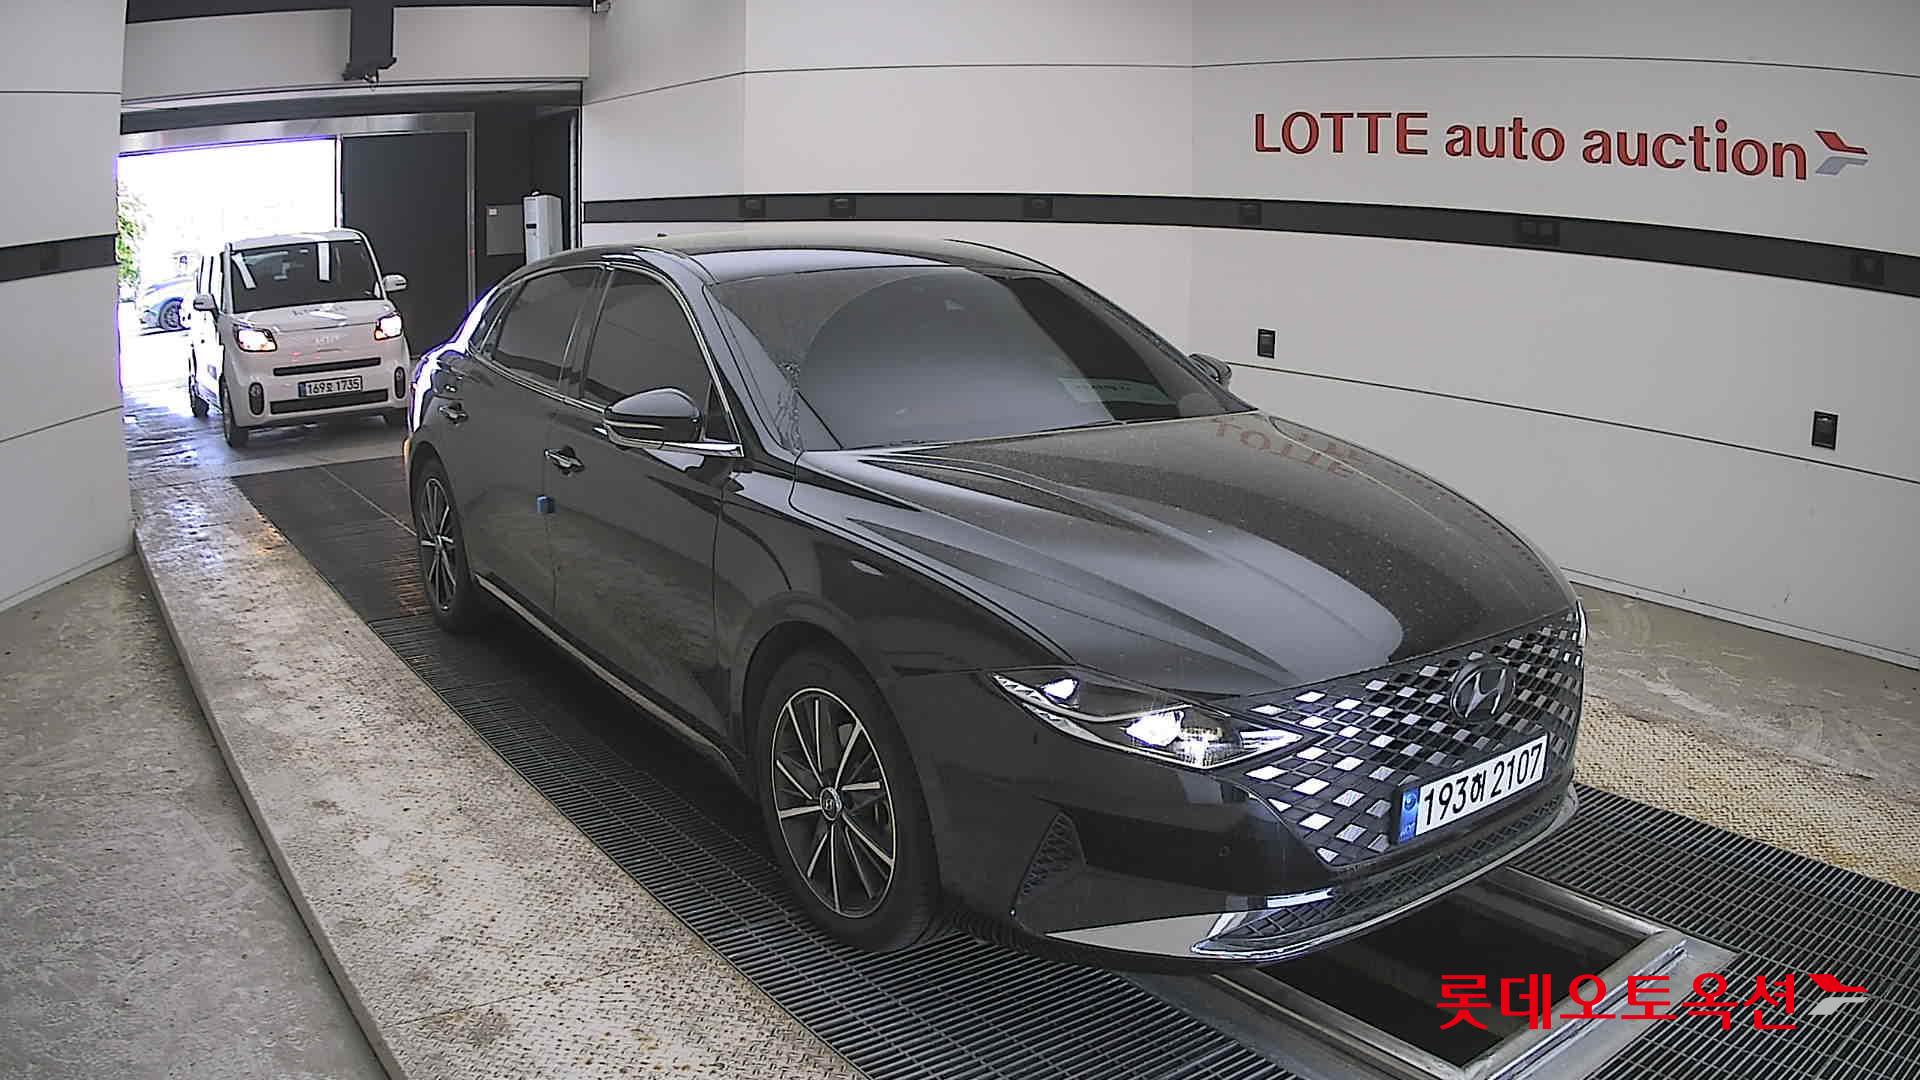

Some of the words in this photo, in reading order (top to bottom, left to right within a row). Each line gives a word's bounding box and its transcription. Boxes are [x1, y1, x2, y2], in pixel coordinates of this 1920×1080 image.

[1254, 111, 1429, 155] LOTTE
[1445, 117, 1566, 162] auto
[1582, 119, 1807, 180] auction
[337, 379, 360, 391] 1735
[1424, 769, 1486, 825] 193허
[1491, 743, 1543, 798] 2107
